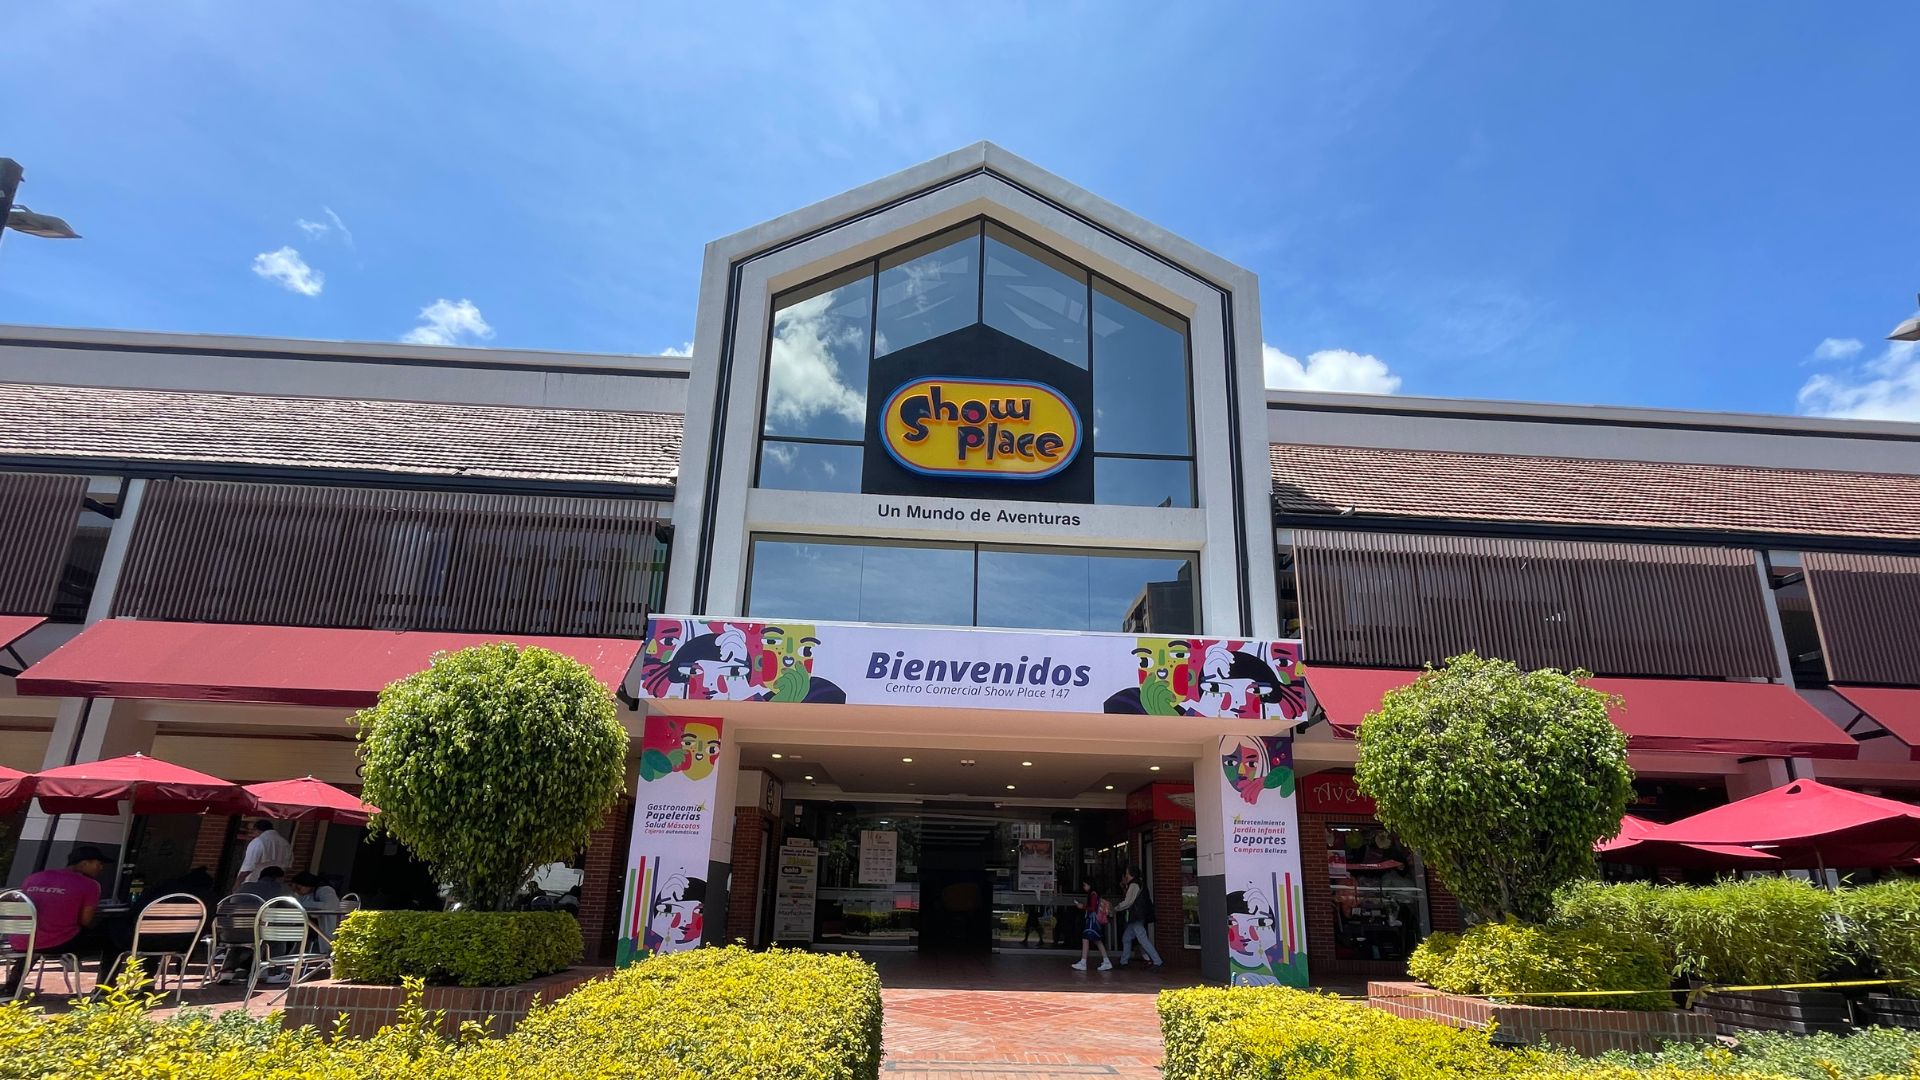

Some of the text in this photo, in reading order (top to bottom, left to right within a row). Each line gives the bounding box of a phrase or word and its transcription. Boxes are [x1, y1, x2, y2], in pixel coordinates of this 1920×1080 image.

[878, 504, 1081, 526] Un Mundo de Aventuras
[866, 651, 1091, 687] Bienvenidos
[885, 683, 1070, 699] Centro Comercial Show Place 147
[1234, 834, 1286, 846] Deportes
